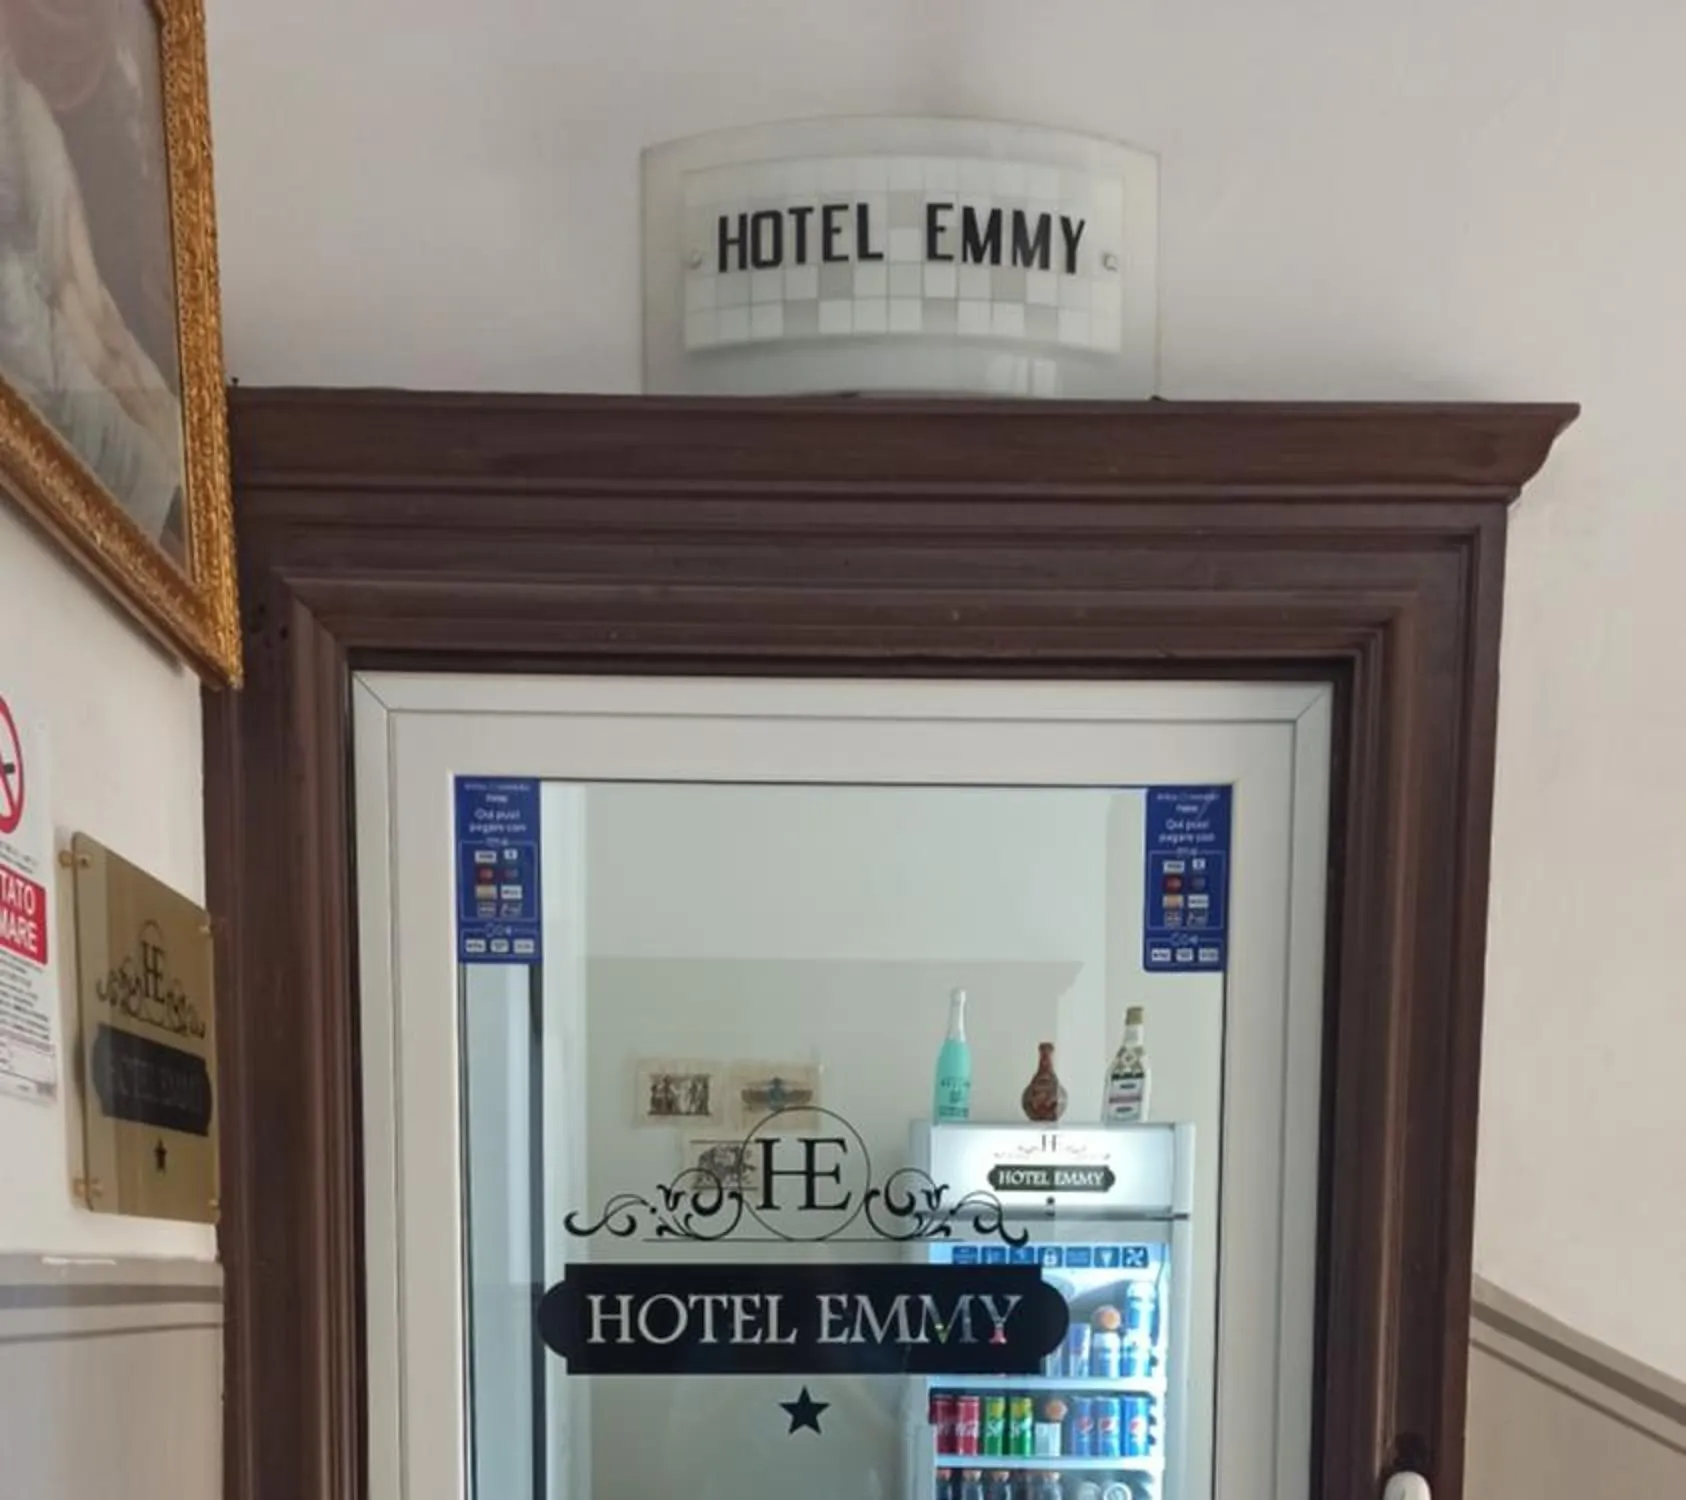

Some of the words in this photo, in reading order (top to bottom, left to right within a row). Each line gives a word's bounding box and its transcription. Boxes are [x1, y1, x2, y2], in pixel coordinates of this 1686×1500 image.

[718, 203, 883, 272] HOTEL
[926, 203, 1085, 274] EMMY
[755, 1137, 852, 1211] HE
[998, 1169, 1050, 1186] HOTEL
[1054, 1170, 1105, 1186] EMMY
[587, 1293, 798, 1344] HOTEL
[817, 1293, 1023, 1345] EMMY
